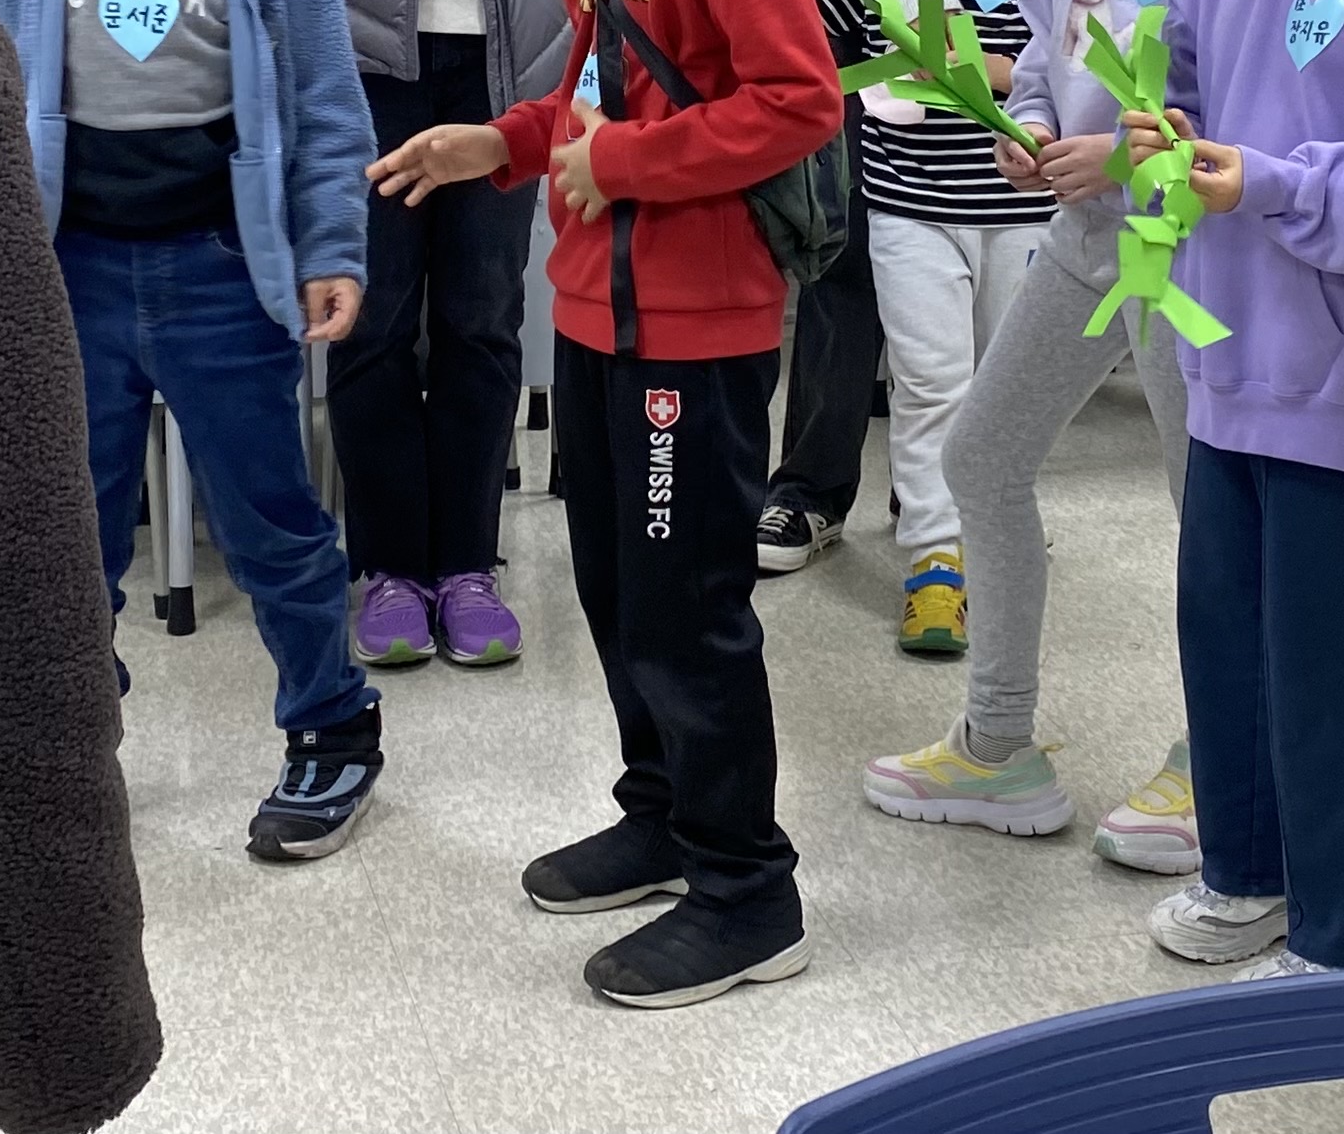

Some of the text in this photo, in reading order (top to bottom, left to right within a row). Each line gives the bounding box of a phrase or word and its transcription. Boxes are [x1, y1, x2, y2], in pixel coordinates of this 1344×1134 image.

[104, 1, 168, 35] 문서준
[646, 431, 674, 539] SWISS FC
